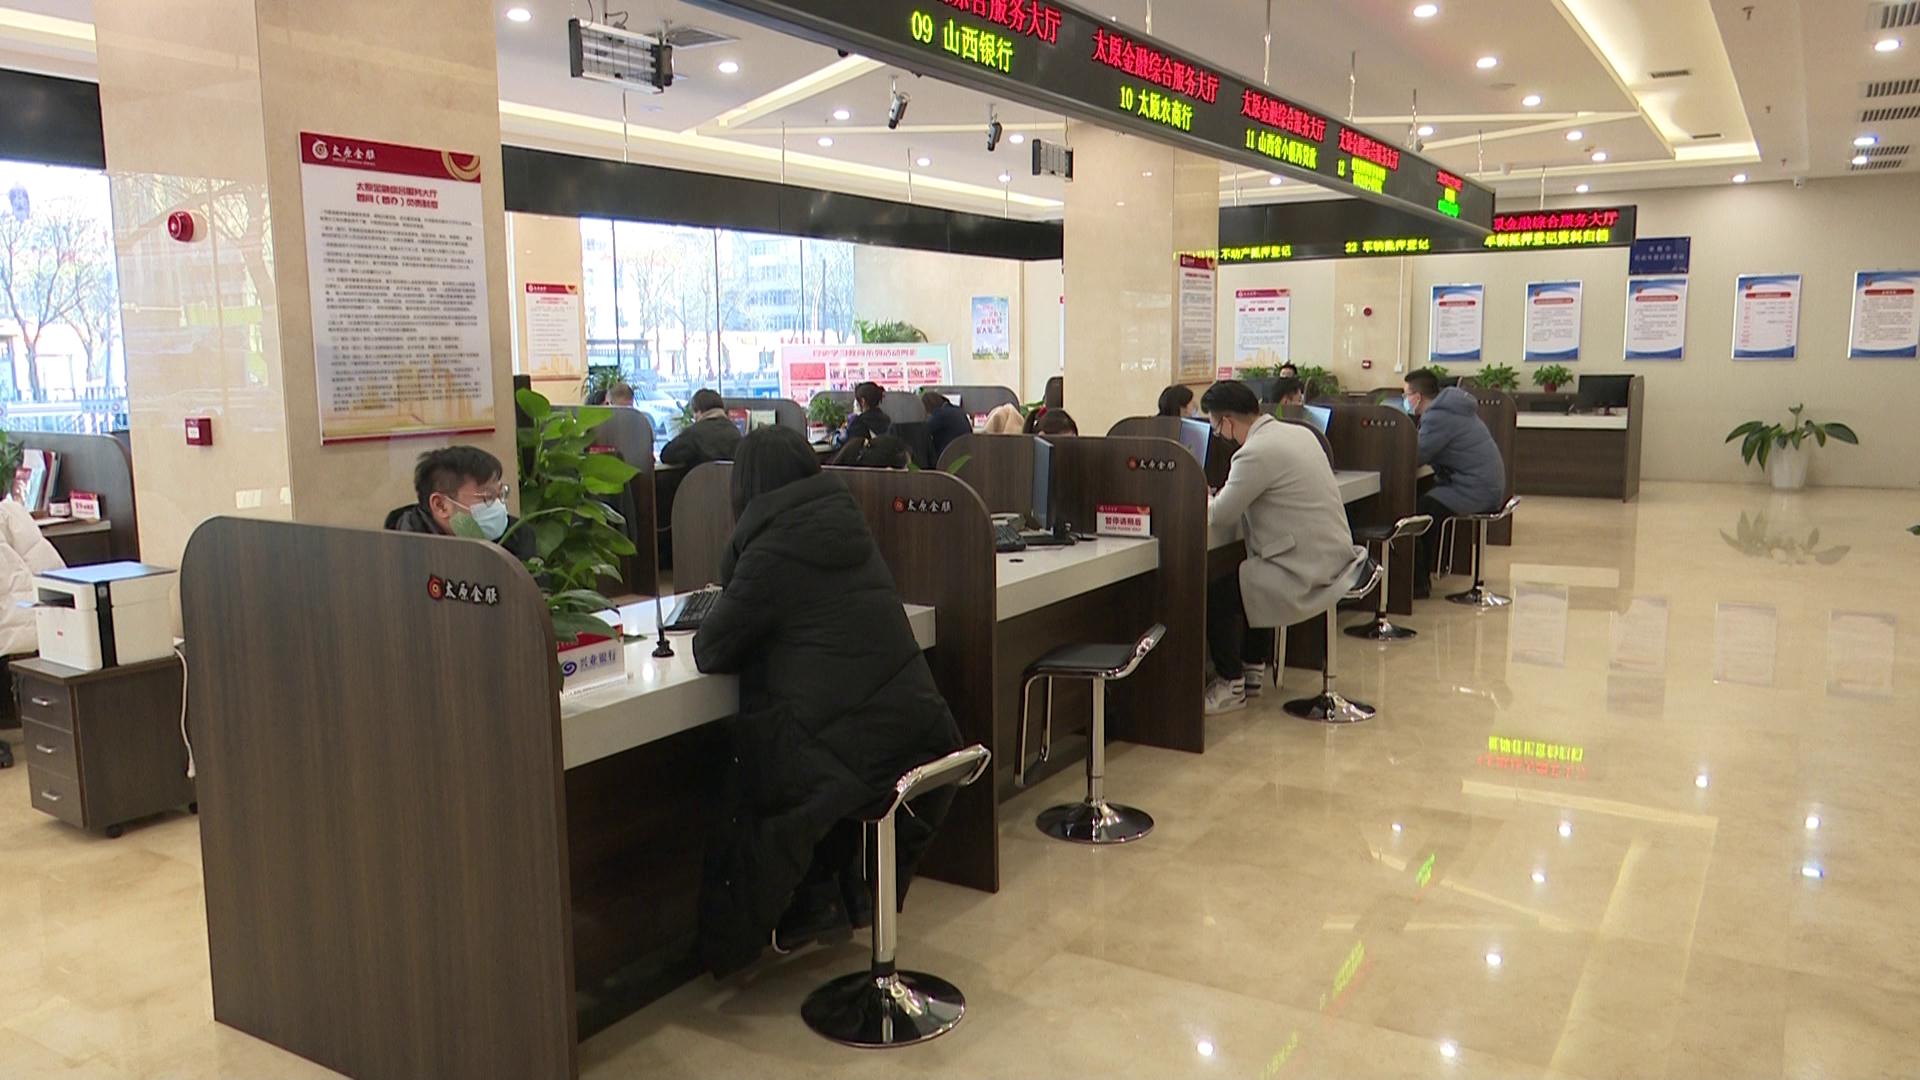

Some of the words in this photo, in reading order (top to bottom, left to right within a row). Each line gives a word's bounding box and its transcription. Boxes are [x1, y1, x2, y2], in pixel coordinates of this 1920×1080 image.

[911, 11, 933, 43] 09
[944, 19, 1013, 72] 山西银行
[948, 0, 1061, 43] 合服务大厅
[1093, 29, 1218, 103] 太原金融综合服务大厅
[1120, 86, 1134, 110] 10
[1138, 89, 1193, 130] 太原农商行
[1242, 90, 1325, 141] 太原金融综合服务大厅
[1246, 129, 1255, 149] 11
[445, 581, 498, 605] 太原金融
